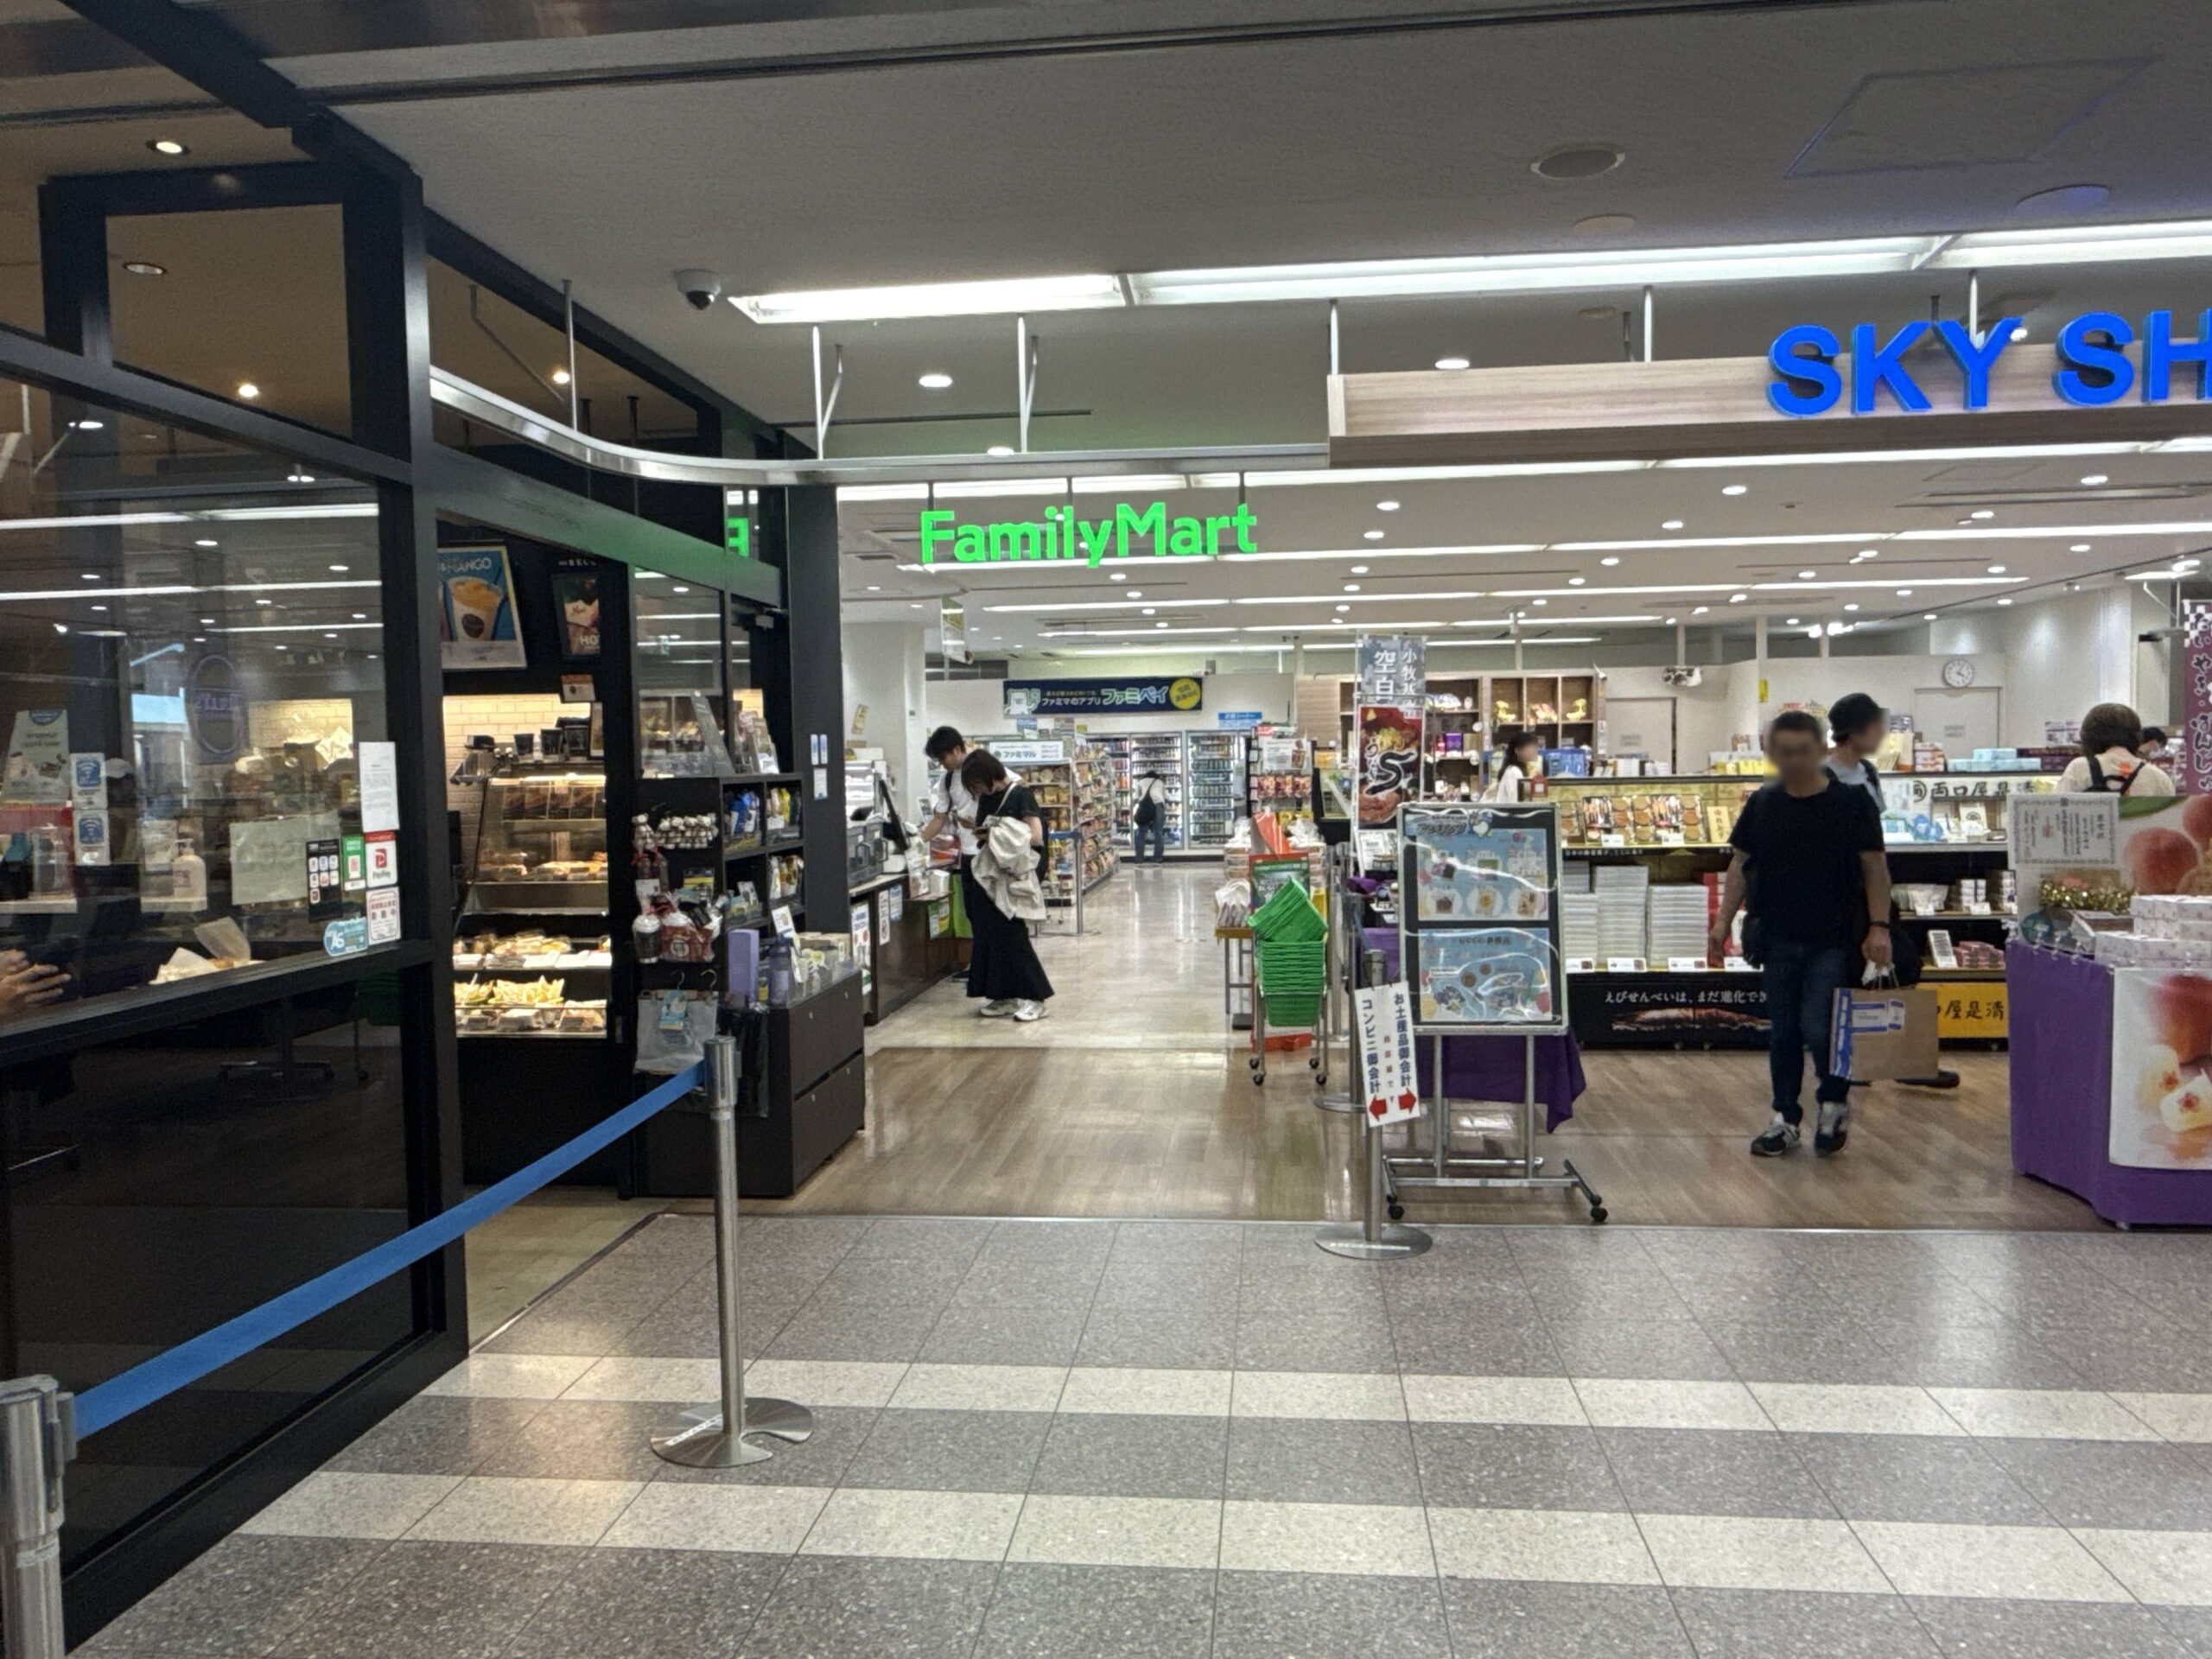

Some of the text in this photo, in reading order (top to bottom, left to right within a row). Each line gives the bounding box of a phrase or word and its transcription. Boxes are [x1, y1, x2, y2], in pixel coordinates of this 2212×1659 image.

[1766, 308, 2212, 416] SKY SH
[920, 502, 1257, 568] FamilyMart
[1362, 999, 1381, 1094] コンビニ御会計
[1394, 993, 1412, 1087] お土産品御会計
[1936, 1000, 2005, 1020] 屋是清
